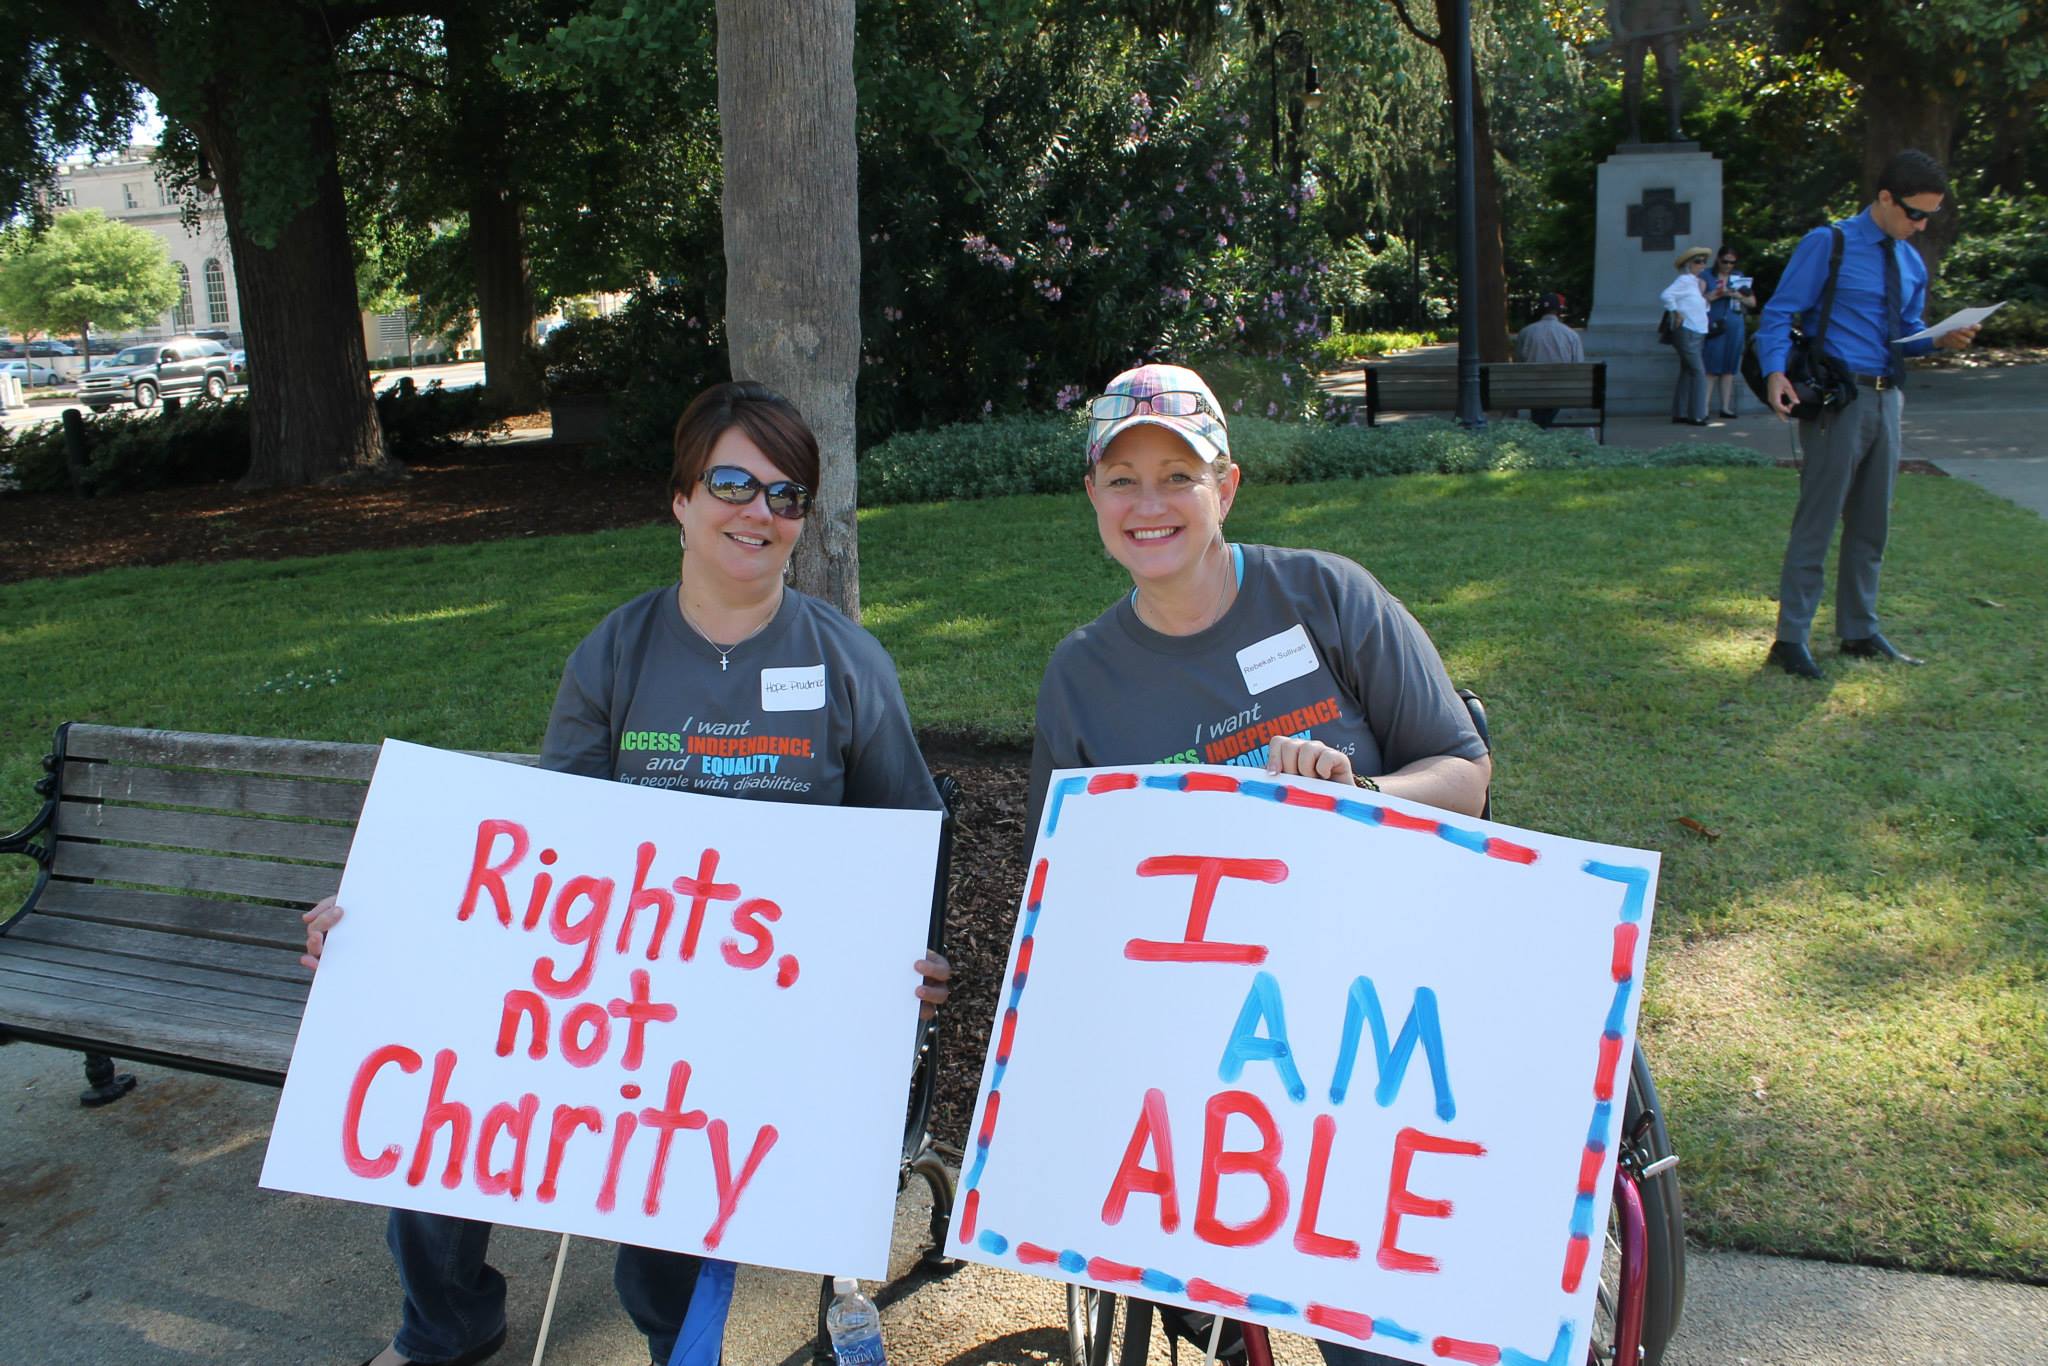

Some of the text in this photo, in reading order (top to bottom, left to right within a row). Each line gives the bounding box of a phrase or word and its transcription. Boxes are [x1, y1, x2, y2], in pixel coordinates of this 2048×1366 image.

[646, 754, 780, 777] and EQUALITY
[682, 716, 752, 736] I want
[687, 735, 815, 759] INDEPENDENCE,
[1195, 702, 1263, 745] I want
[640, 774, 689, 790] people
[693, 776, 729, 791] with
[457, 818, 801, 1000] Rights,
[1123, 854, 1290, 966] I
[495, 968, 678, 1071] not
[1217, 970, 1457, 1123] AM
[342, 1043, 780, 1252] Charity
[1100, 1087, 1489, 1274] ABLE
